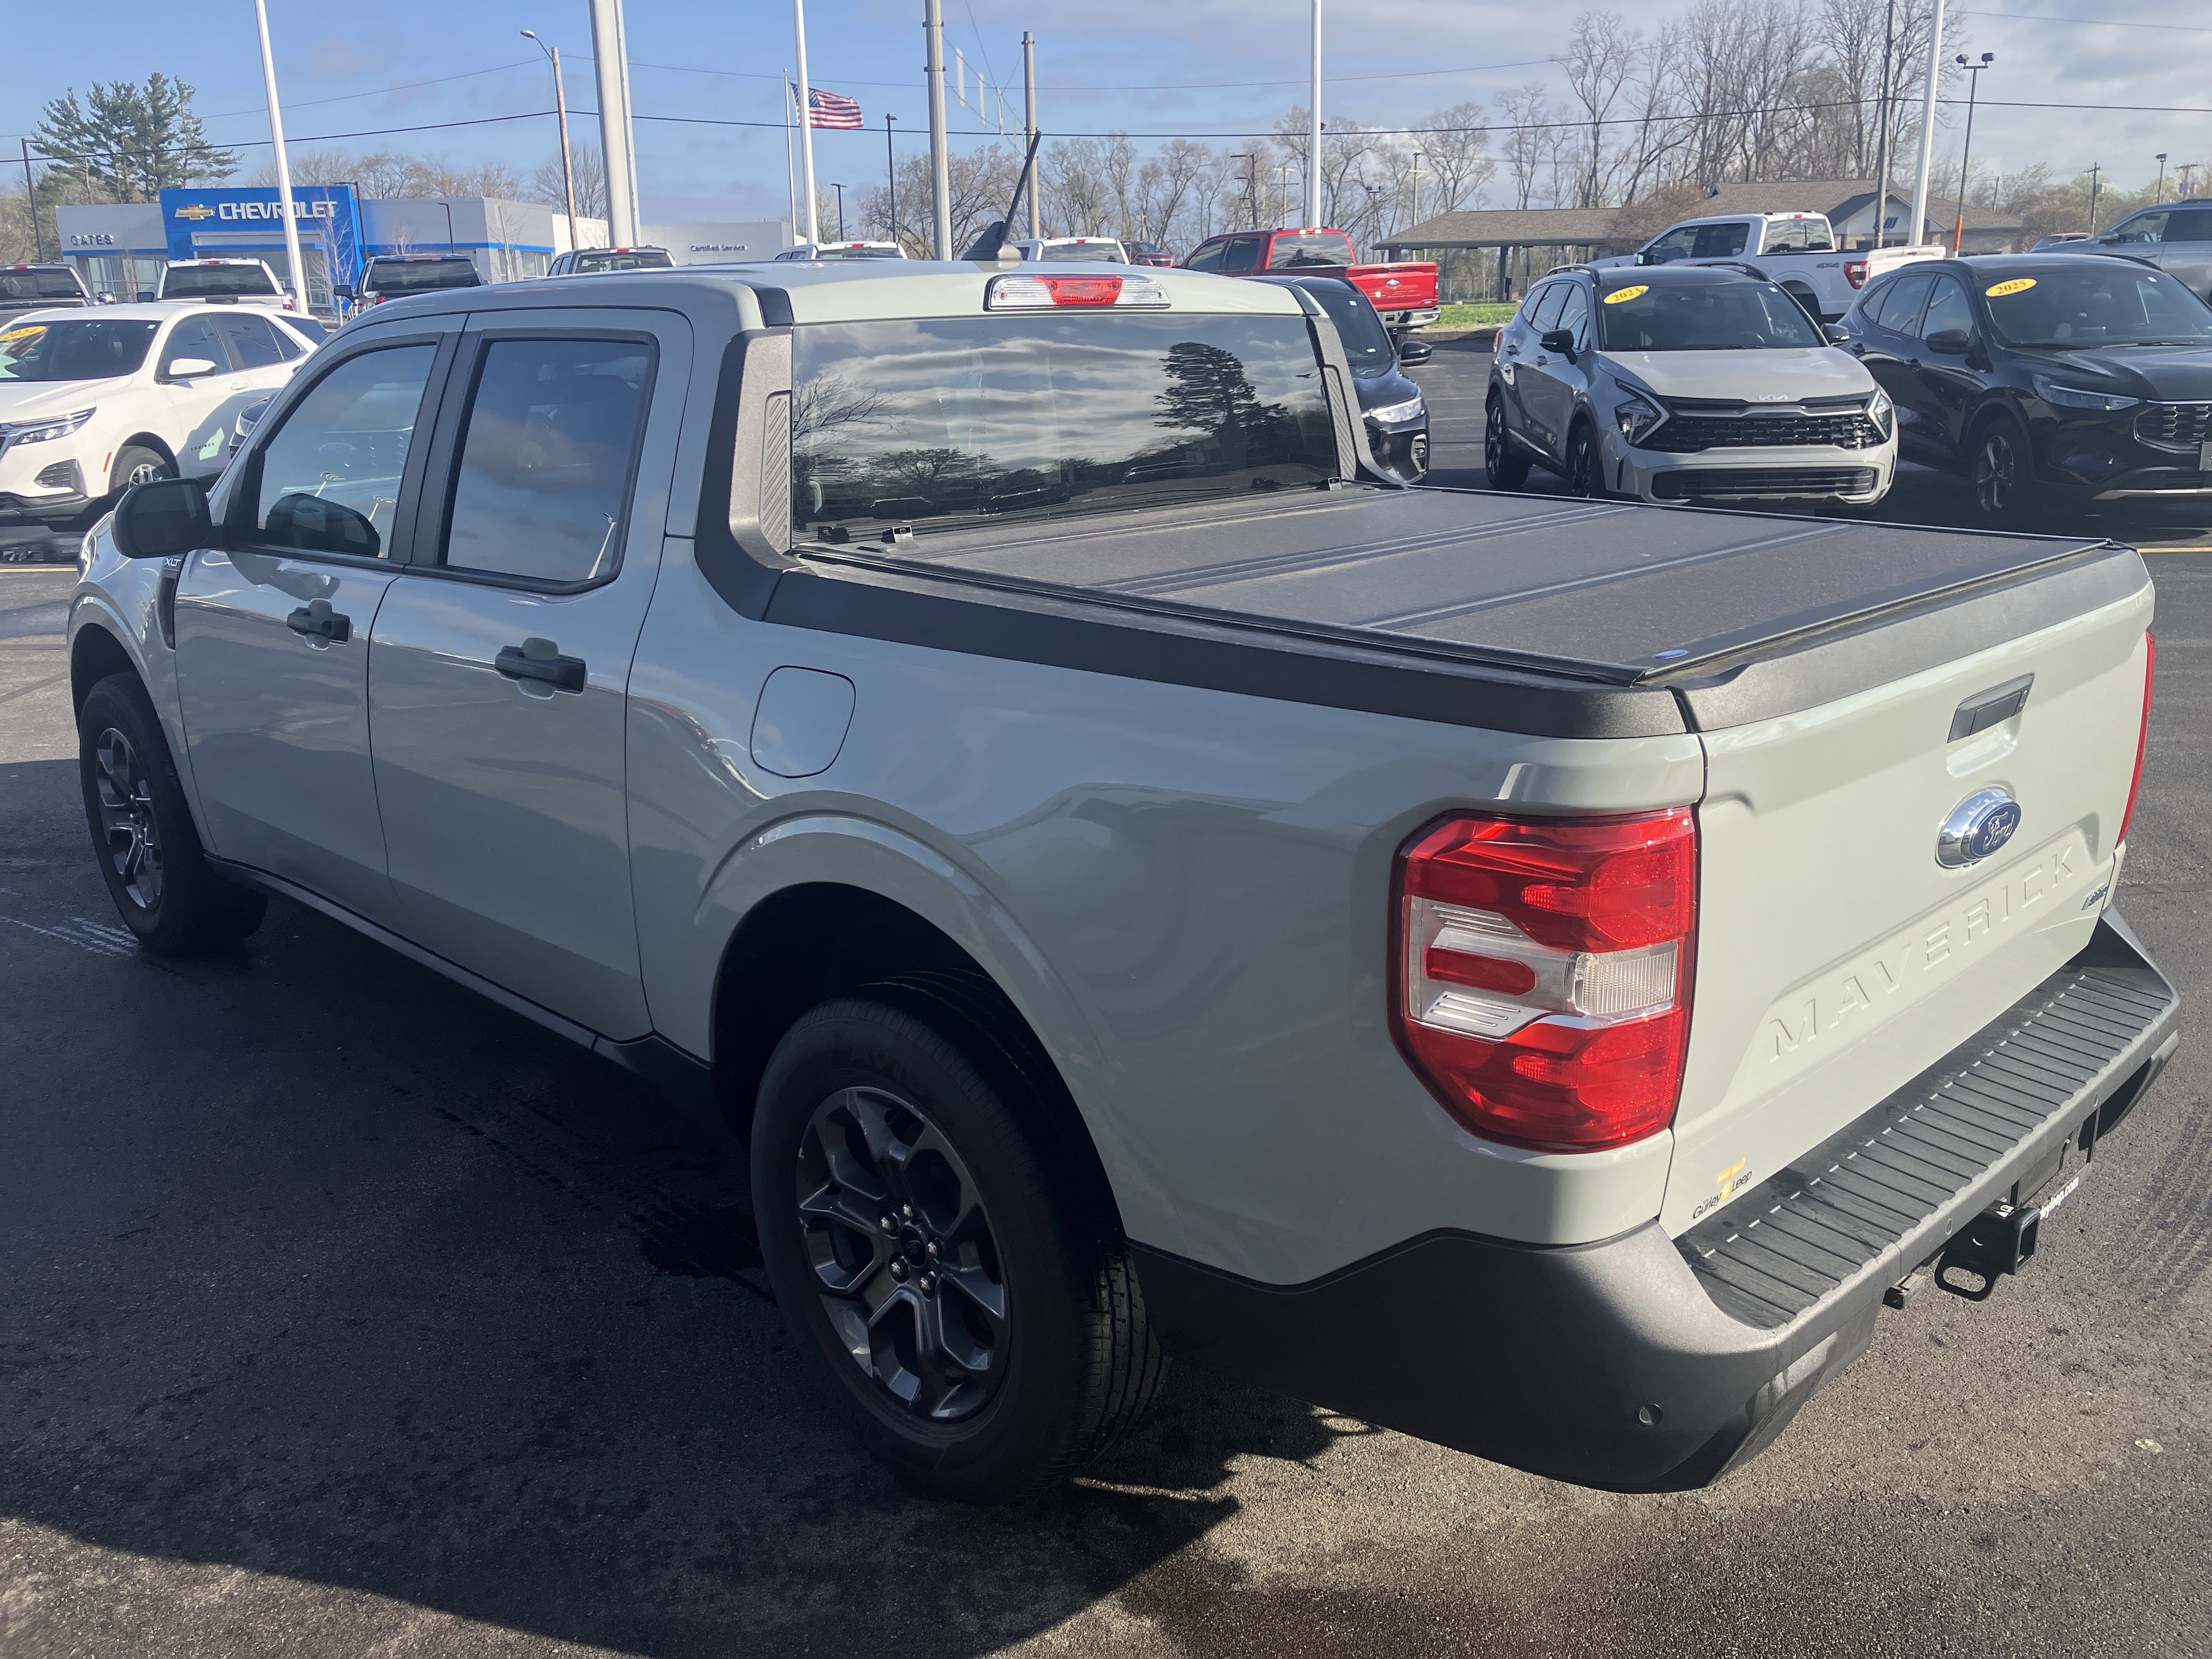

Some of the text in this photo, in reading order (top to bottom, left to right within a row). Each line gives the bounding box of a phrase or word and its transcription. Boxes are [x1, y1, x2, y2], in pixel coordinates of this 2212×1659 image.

[70, 234, 114, 245] GATES
[1995, 280, 2027, 295] 2025
[164, 557, 182, 567] XLT
[1983, 811, 2015, 851] Ford
[1769, 844, 2074, 1063] MAVERICK
[1692, 1170, 1752, 1220] Gurley Leep
